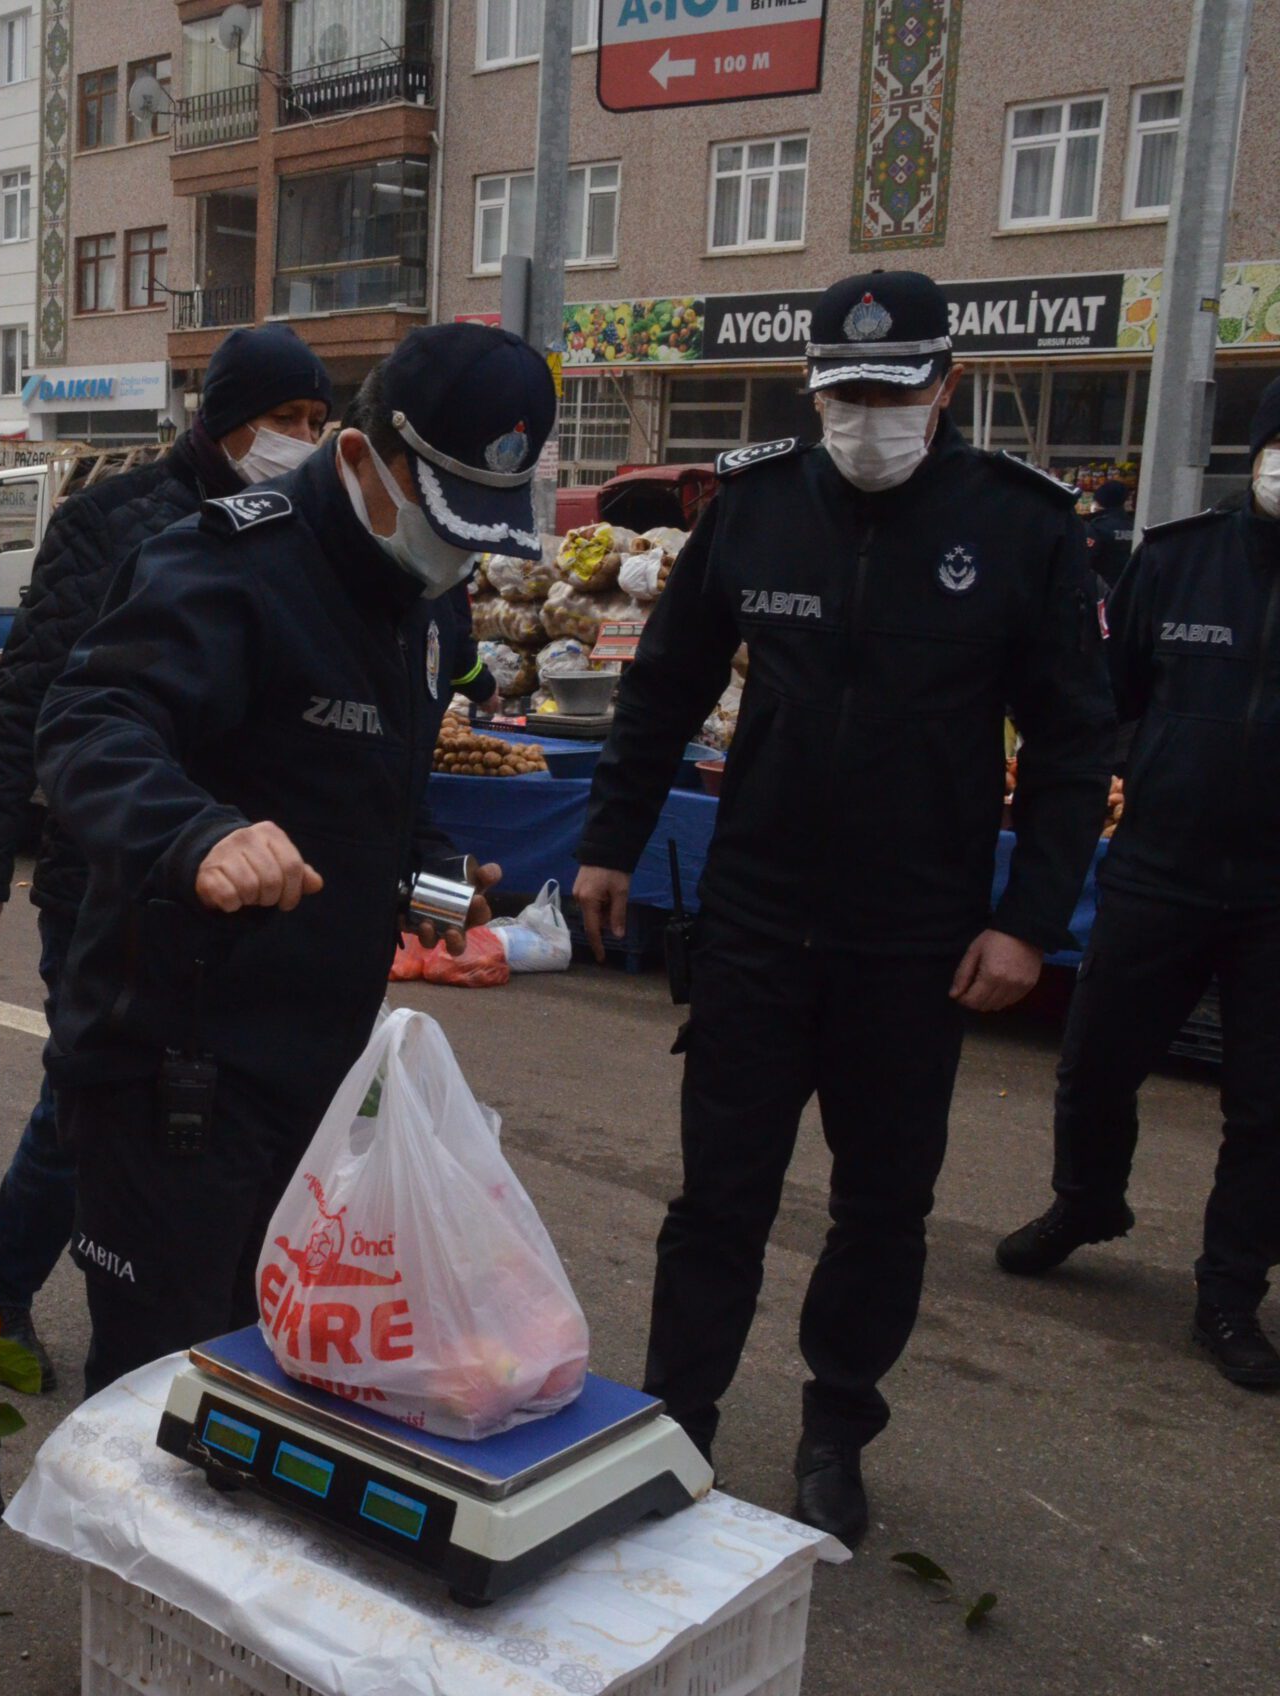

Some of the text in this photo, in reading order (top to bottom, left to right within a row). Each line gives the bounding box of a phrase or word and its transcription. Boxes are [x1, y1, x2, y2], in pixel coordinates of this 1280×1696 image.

[714, 52, 770, 73] 100 M
[717, 290, 1106, 344] AYGÖR BAKLİYAT
[39, 377, 114, 400] DAIKIN
[740, 589, 822, 618] ZABITA
[1160, 621, 1233, 646] ZABITA
[78, 1232, 135, 1283] ZABITA
[260, 1263, 415, 1366] EMRE
